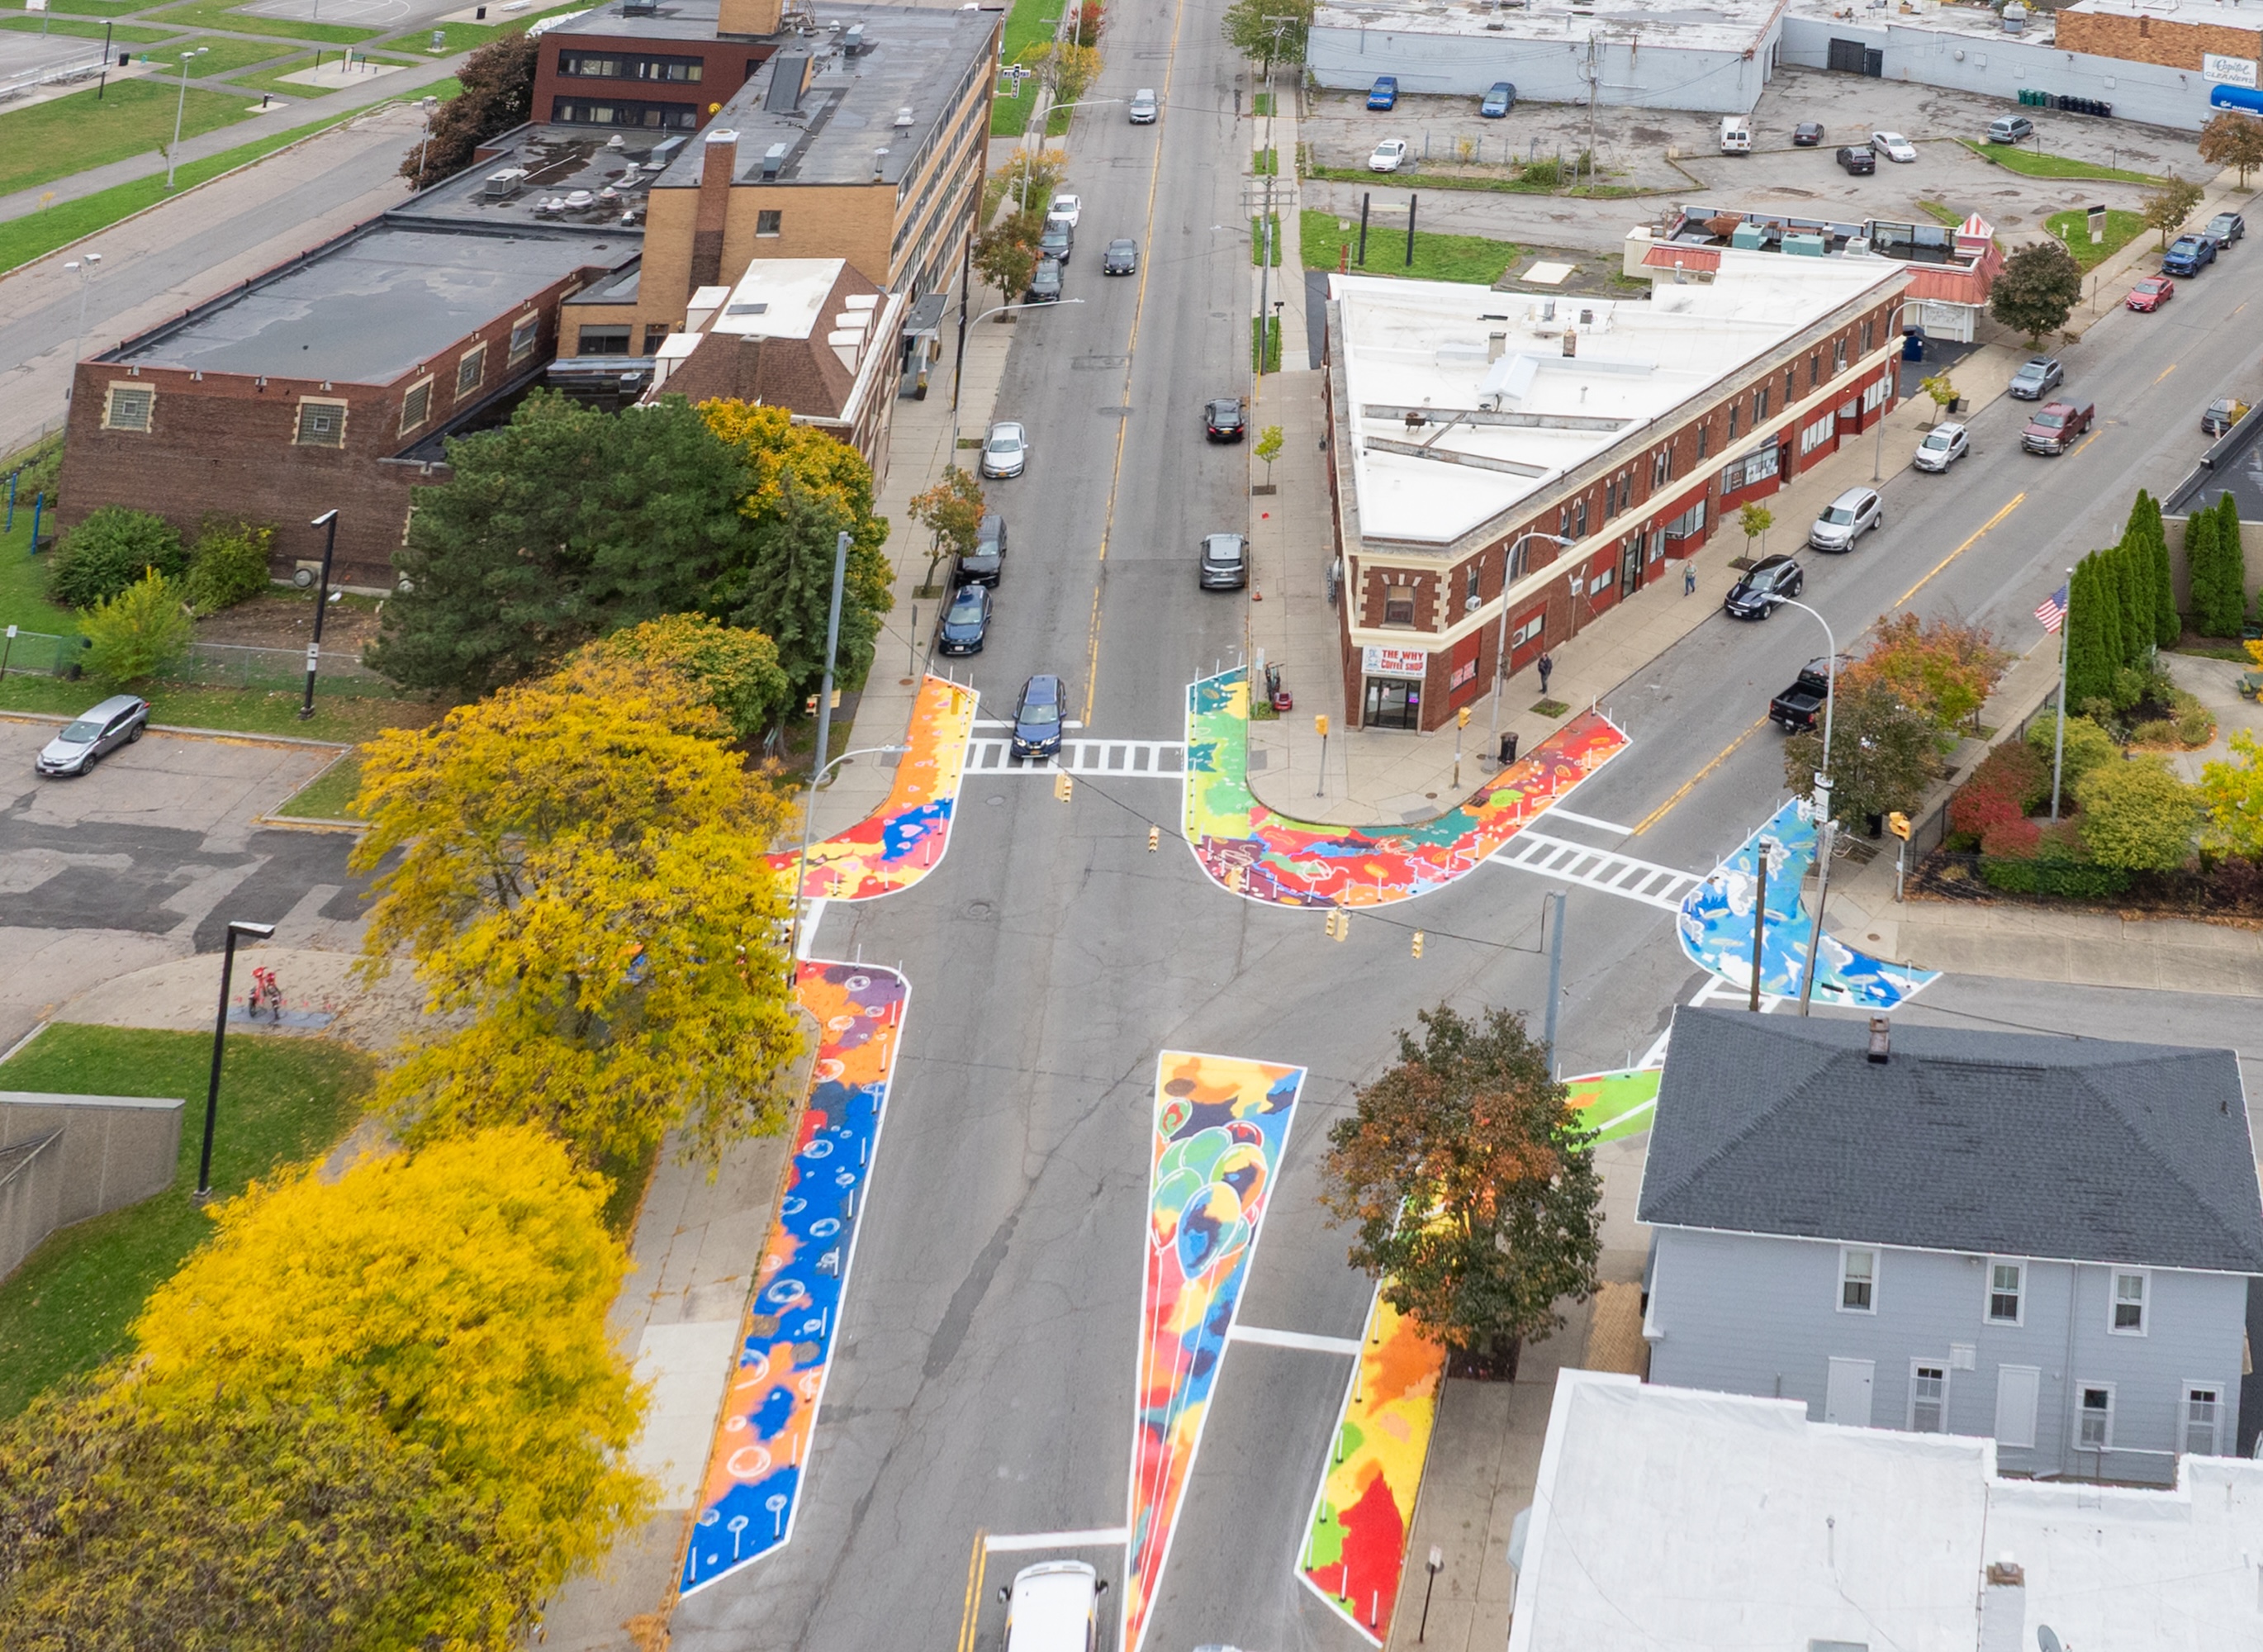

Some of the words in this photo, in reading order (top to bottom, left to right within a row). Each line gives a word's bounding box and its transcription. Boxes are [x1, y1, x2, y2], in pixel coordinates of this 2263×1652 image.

[2213, 59, 2251, 74] Capitol
[2205, 72, 2254, 83] CLEANERS
[1383, 650, 1398, 658] THE
[1402, 651, 1424, 660] WHY
[1381, 659, 1402, 670] COFFEE
[1405, 662, 1423, 671] SHOP
